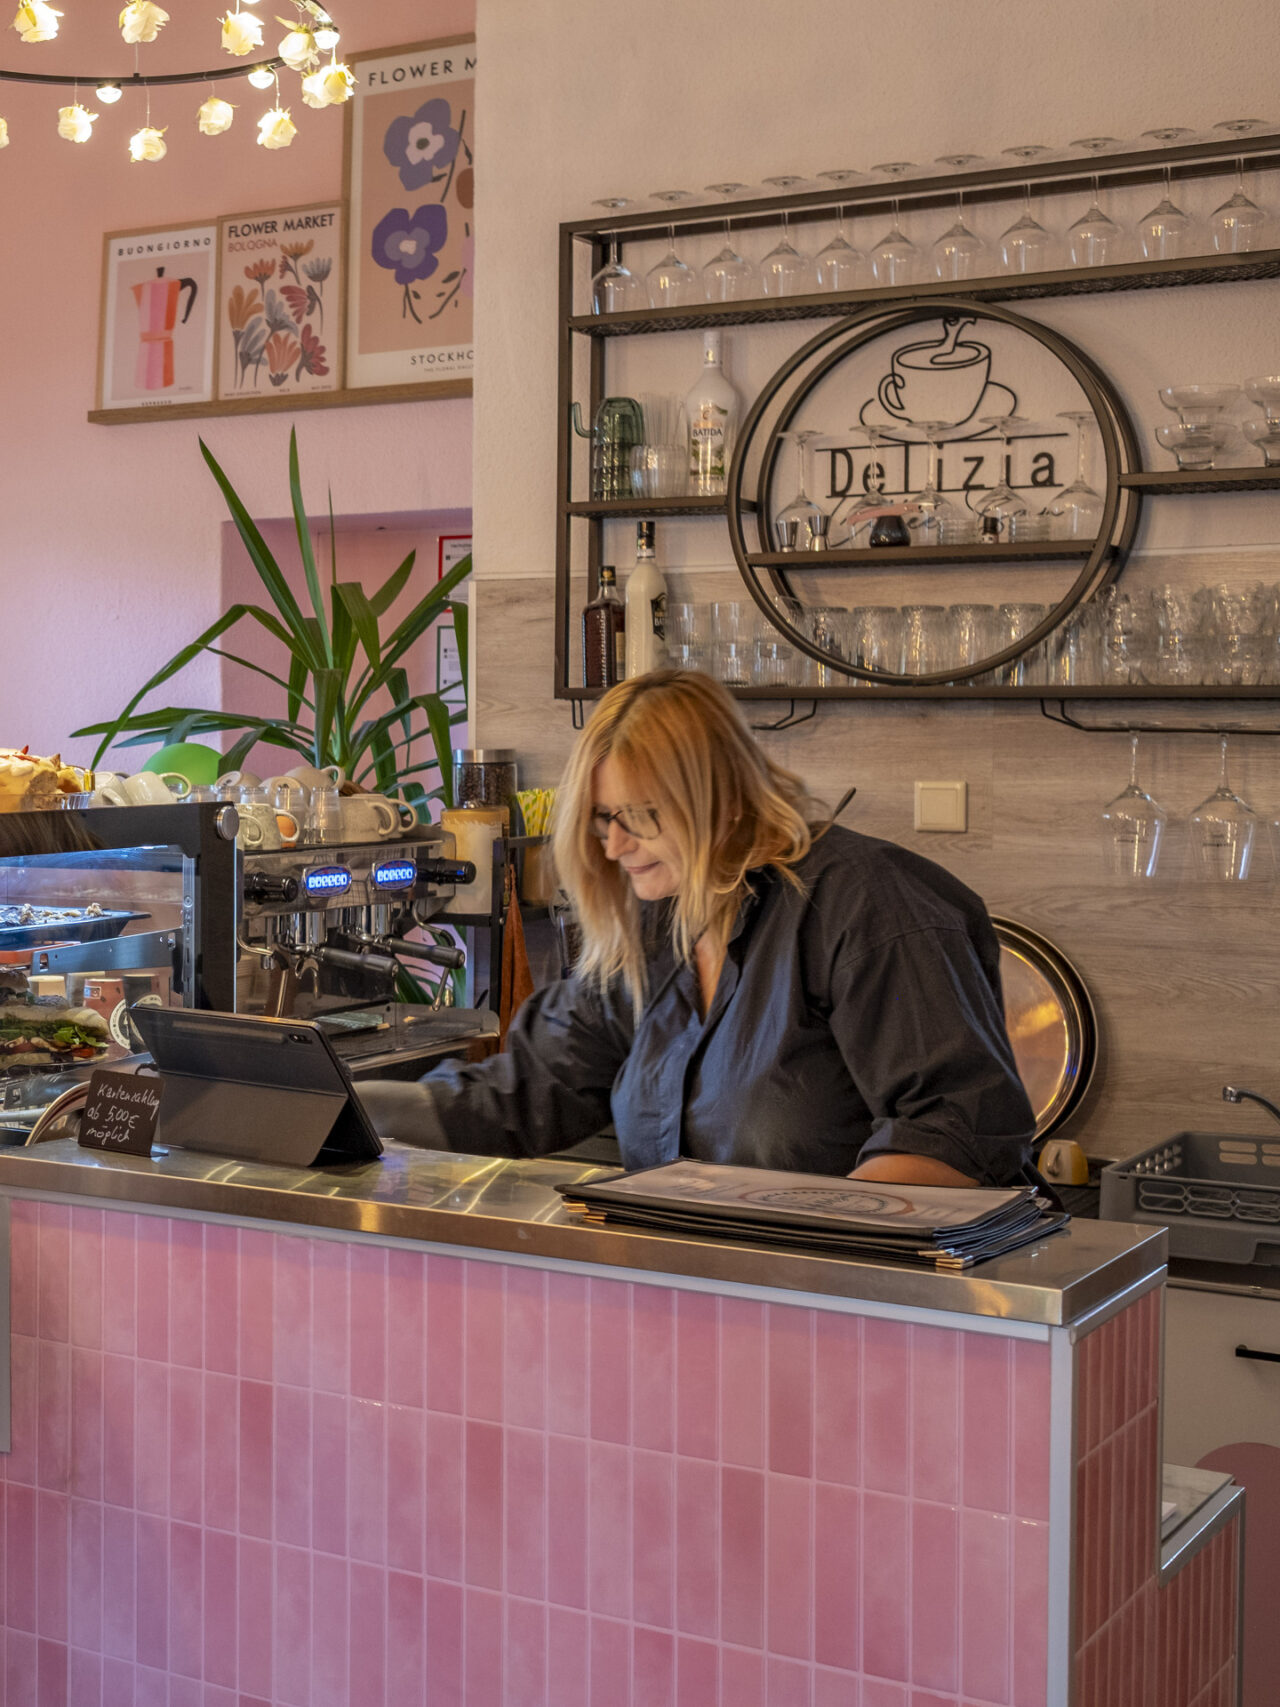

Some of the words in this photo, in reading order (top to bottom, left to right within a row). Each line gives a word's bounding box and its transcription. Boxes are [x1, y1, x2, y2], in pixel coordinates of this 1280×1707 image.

[368, 59, 453, 87] FLOWER
[228, 220, 278, 238] FLOWER
[283, 213, 335, 232] MARKET
[118, 237, 212, 257] BUONGIORNO
[228, 238, 278, 253] BOLOGNA
[693, 428, 723, 438] BATIDA
[830, 438, 1055, 498] Delizia
[87, 1103, 99, 1122] ab
